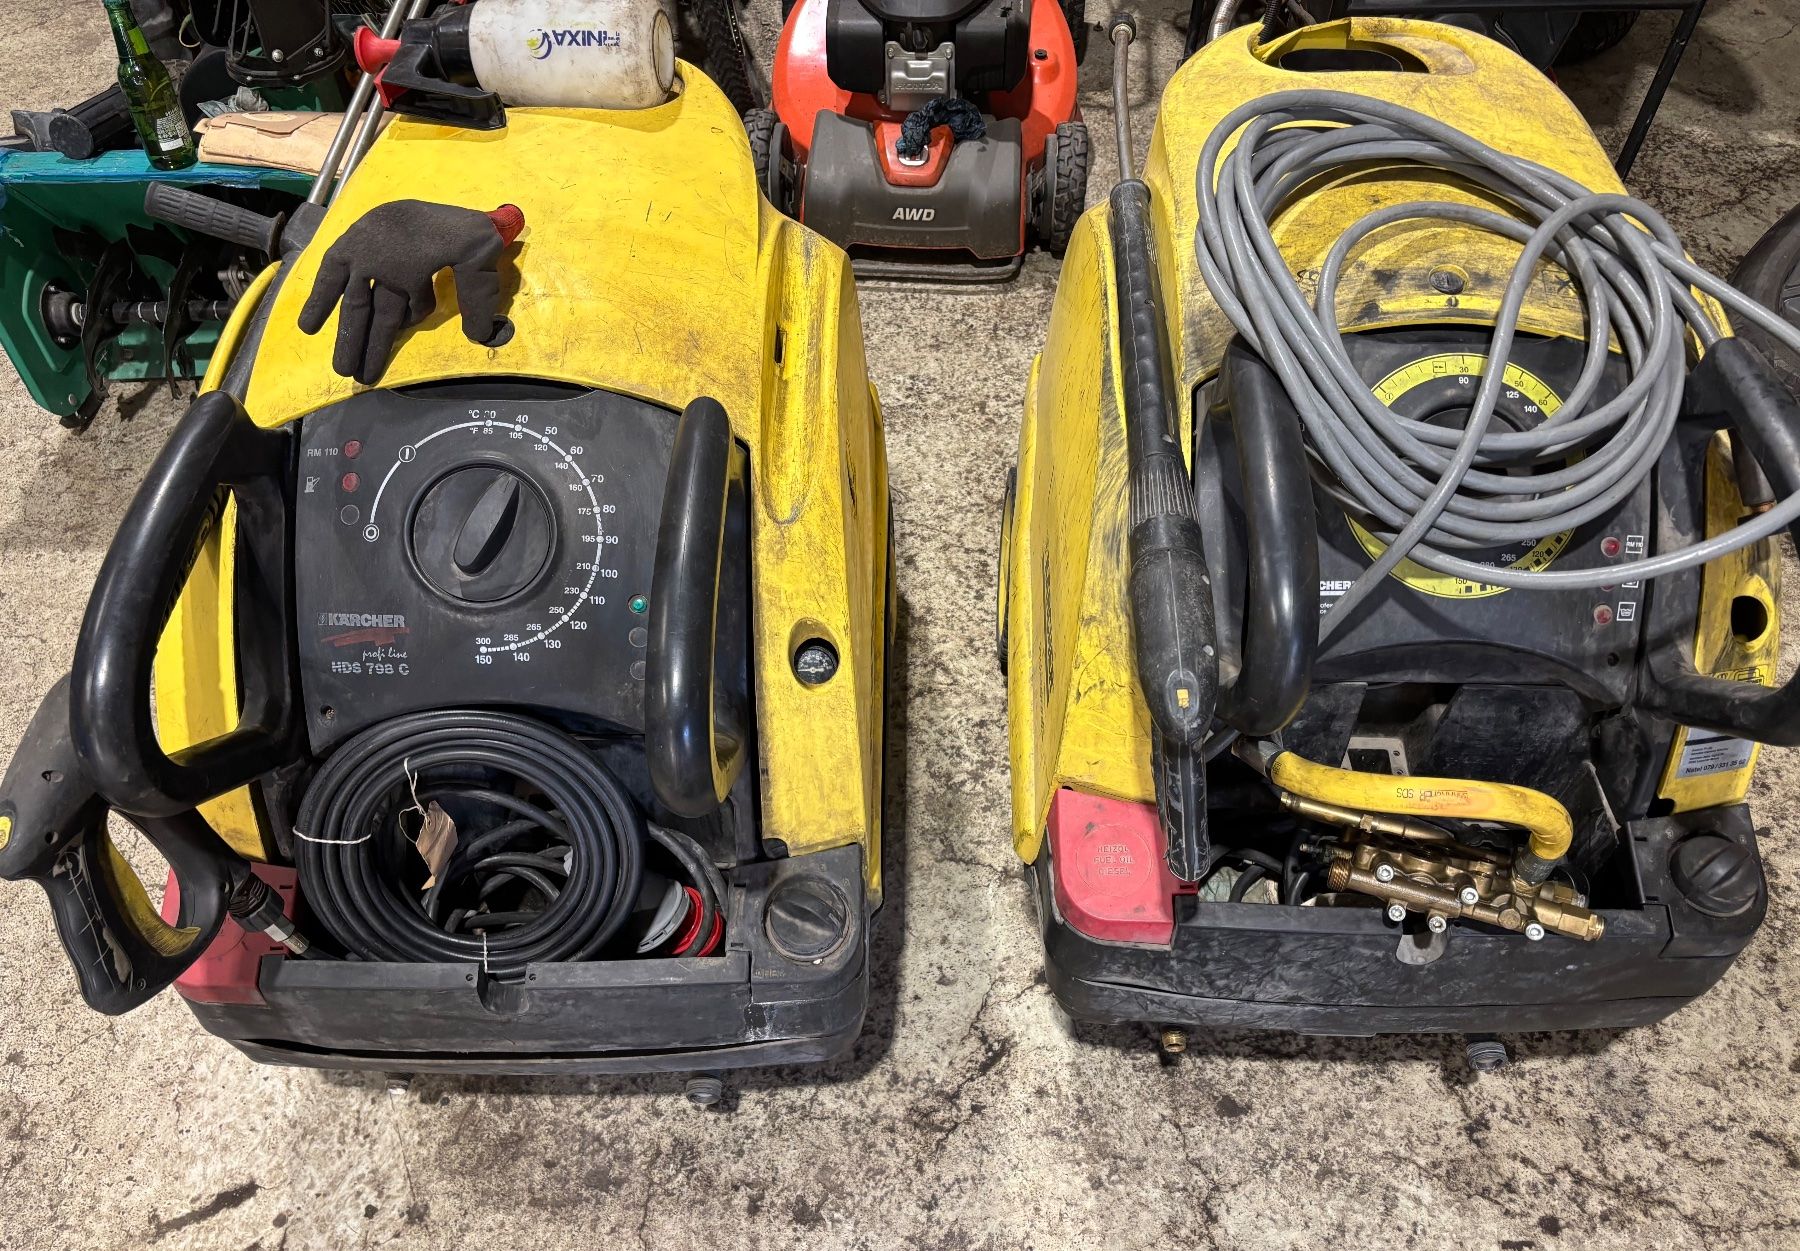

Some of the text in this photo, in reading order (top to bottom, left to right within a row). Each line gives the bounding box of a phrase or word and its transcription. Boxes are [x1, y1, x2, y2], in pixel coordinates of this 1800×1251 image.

[894, 82, 943, 90] HONDA
[892, 207, 935, 221] AWD
[1459, 366, 1469, 374] 30
[1458, 376, 1469, 384] 90
[1514, 380, 1524, 388] 50
[1505, 391, 1520, 399] 125
[1523, 405, 1538, 413] 140
[515, 414, 529, 424] 40
[544, 426, 558, 435] 50
[508, 431, 523, 439] 105
[307, 447, 339, 457] RM 110
[533, 444, 548, 452] 120
[569, 446, 584, 455] 60
[554, 462, 569, 470] 140
[590, 474, 604, 483] 70
[568, 484, 583, 492] 160
[577, 507, 592, 516] 175
[602, 504, 616, 514] 80
[581, 535, 596, 543] 195
[605, 535, 619, 545] 90
[1521, 539, 1537, 547] 250
[1500, 553, 1517, 562] 265
[1532, 550, 1544, 558] 120
[576, 562, 591, 570] 210
[600, 569, 618, 579] 100
[564, 587, 580, 595] 230
[589, 596, 606, 606] 110
[548, 606, 565, 614] 250
[328, 612, 405, 628] KÄRCHER
[526, 623, 542, 631] 265
[569, 620, 587, 630] 120
[475, 637, 491, 645] 300
[503, 634, 519, 642] 285
[543, 639, 562, 649] 130
[474, 654, 493, 665] 150
[512, 652, 530, 662] 140
[331, 661, 410, 676] HDS 798 C
